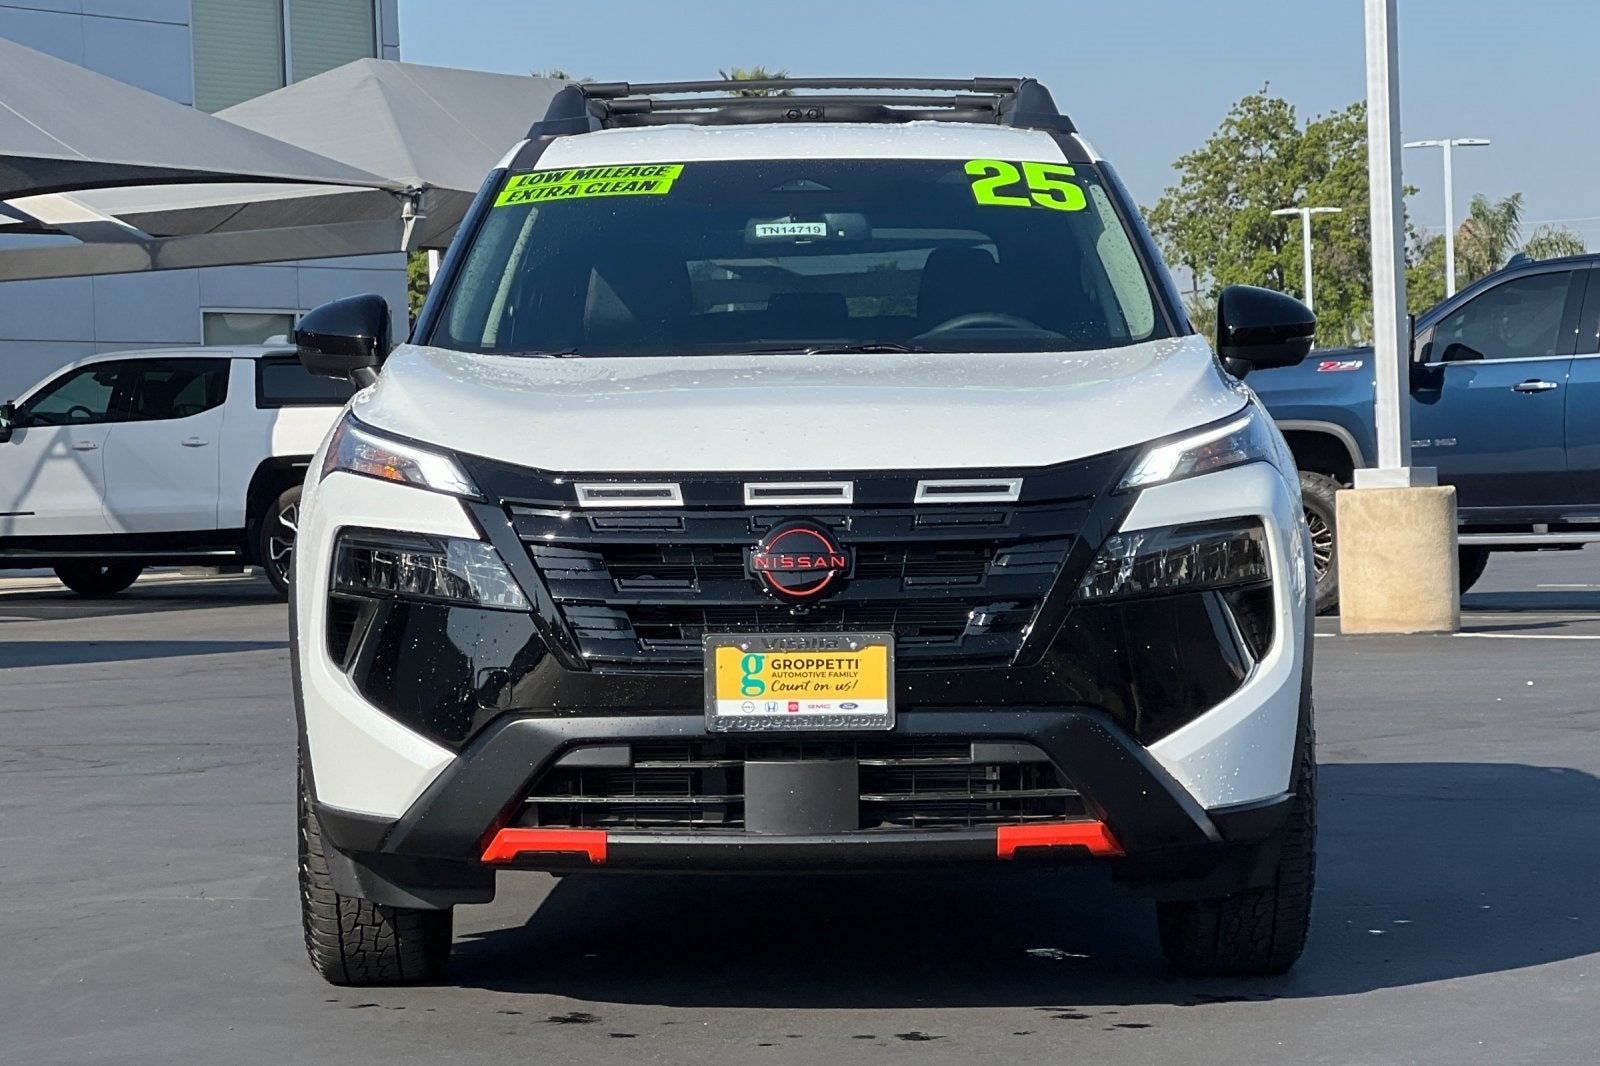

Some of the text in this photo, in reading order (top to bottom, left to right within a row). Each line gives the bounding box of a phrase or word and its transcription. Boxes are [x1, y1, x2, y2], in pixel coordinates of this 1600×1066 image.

[517, 166, 669, 187] LOW MILEAGE
[964, 159, 1087, 211] 25
[506, 180, 658, 203] EXTRA CLEAN
[760, 226, 821, 235] TN14719
[755, 557, 845, 568] NISSAN
[762, 637, 839, 650] Visalia
[771, 658, 859, 670] GROPPETTI
[771, 671, 859, 679] AUTOMOTIVE FAMILY
[771, 680, 859, 692] Count on us!
